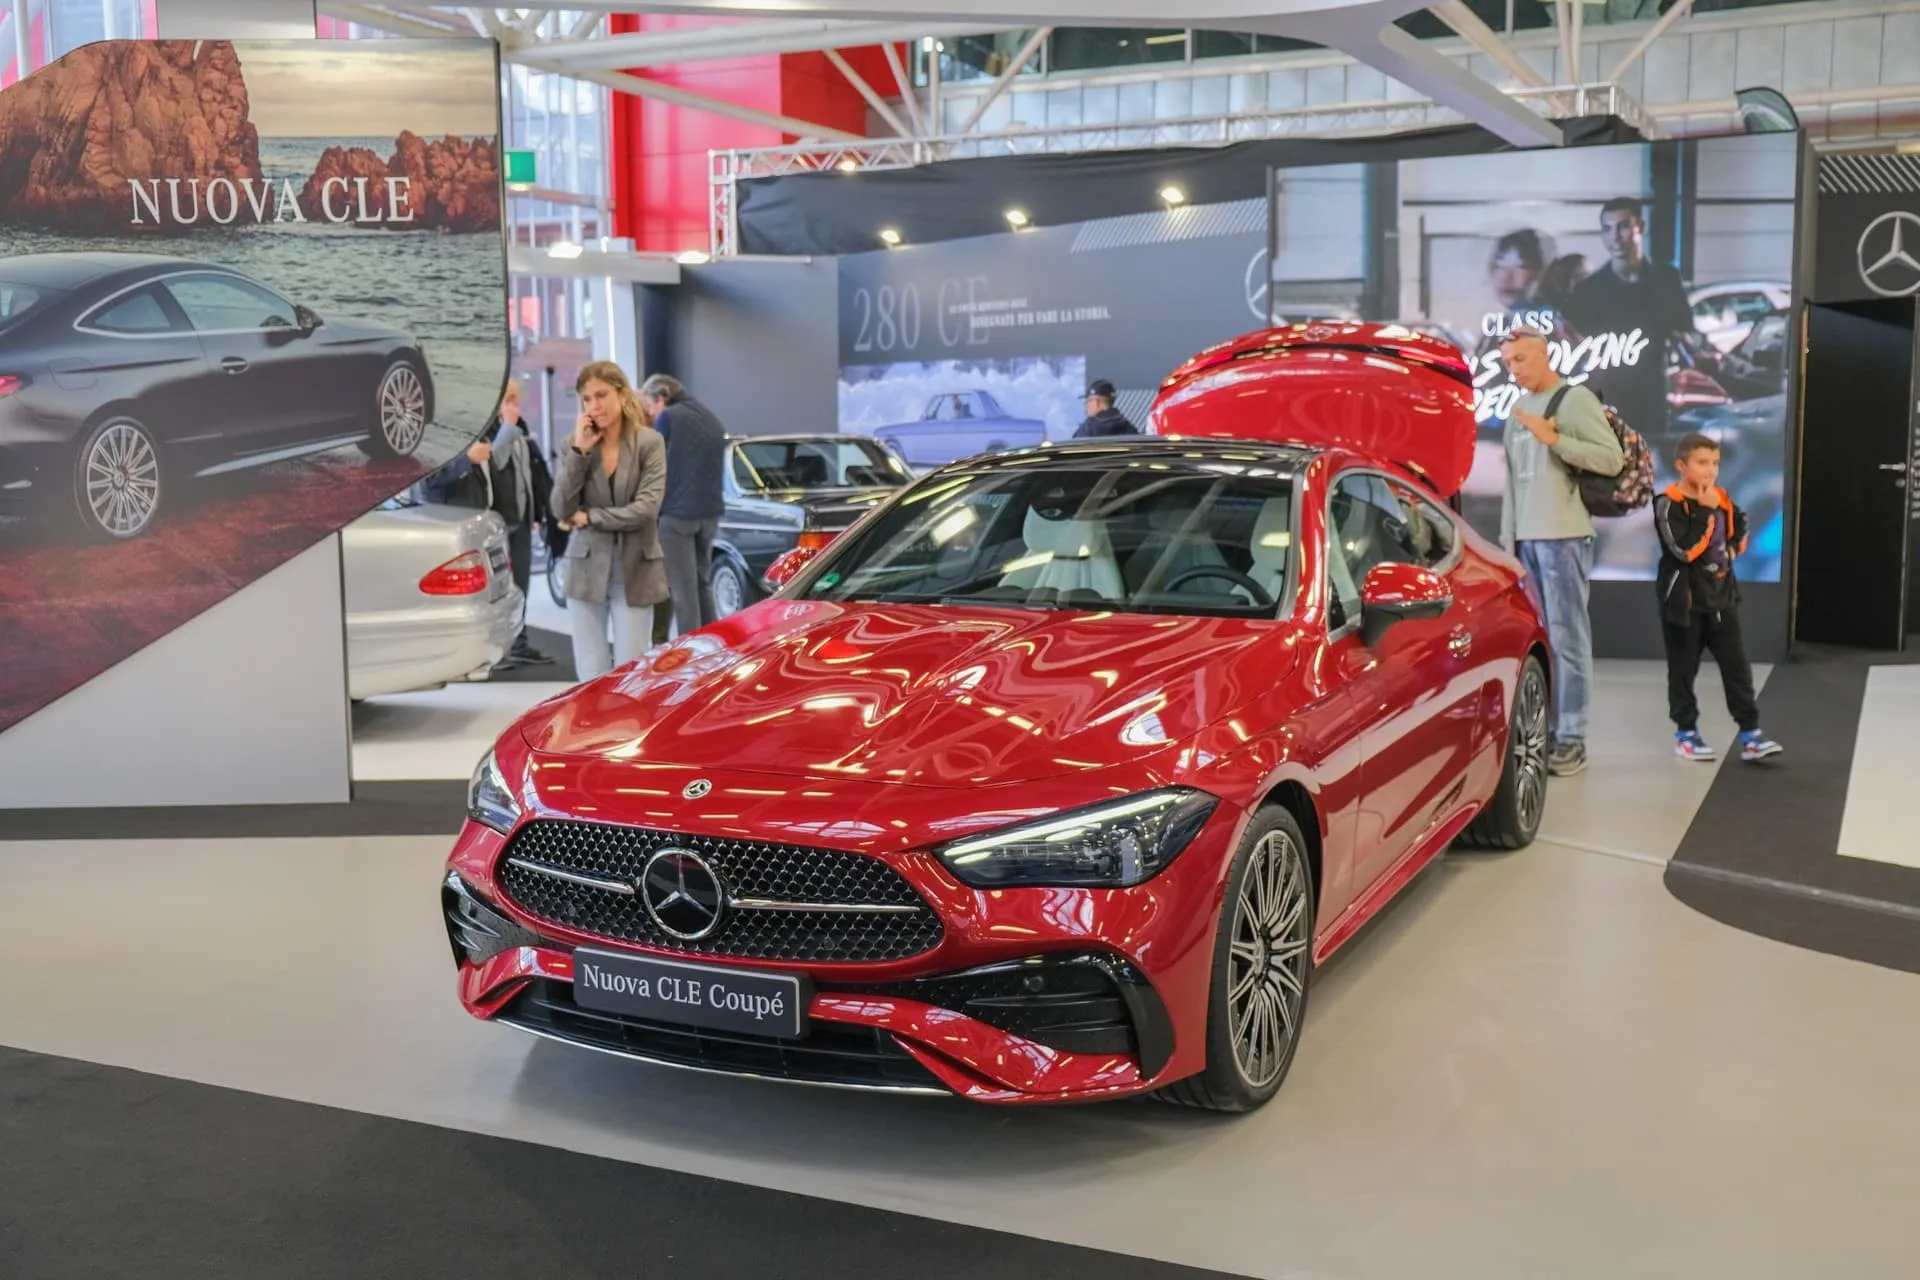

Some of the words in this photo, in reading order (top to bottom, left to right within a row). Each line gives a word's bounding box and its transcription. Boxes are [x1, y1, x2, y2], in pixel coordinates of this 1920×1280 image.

[127, 178, 307, 225] NUOVA
[321, 176, 414, 222] CLE
[854, 281, 920, 351] 280
[937, 274, 989, 347] CE
[1481, 310, 1554, 337] CLASS
[583, 964, 651, 998] Nuova
[657, 976, 702, 1005] CLE
[709, 984, 784, 1020] Coupé
